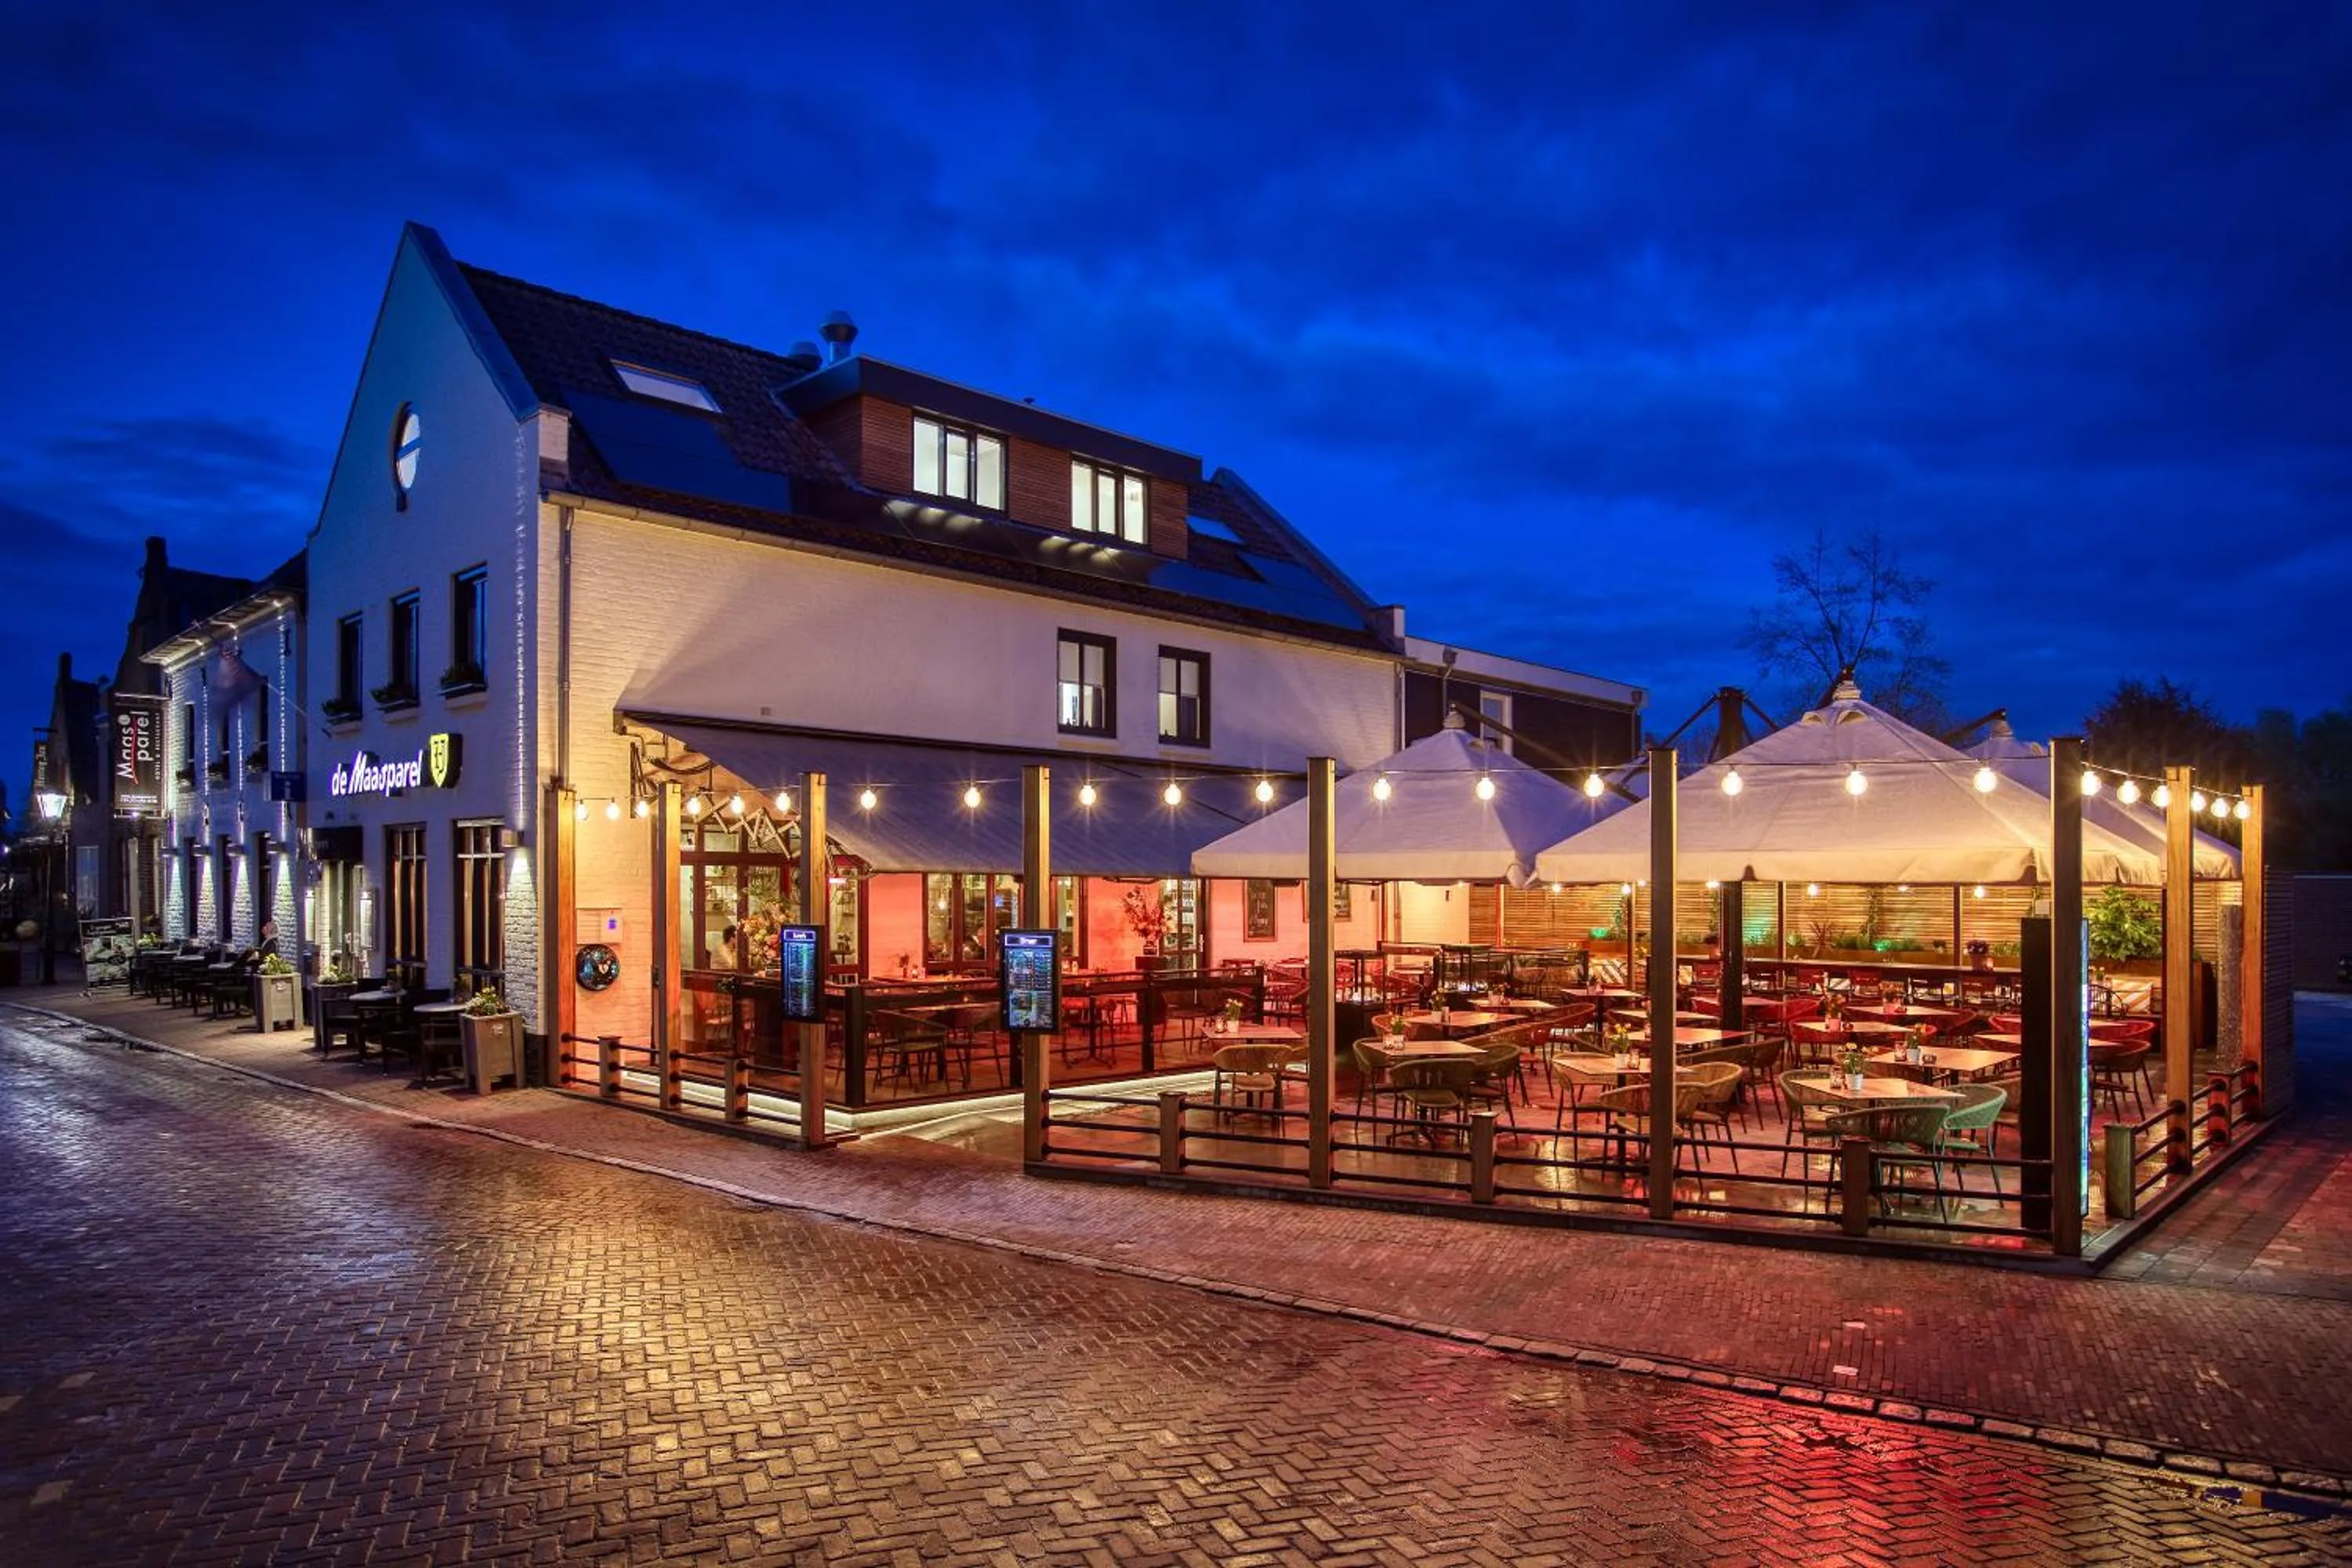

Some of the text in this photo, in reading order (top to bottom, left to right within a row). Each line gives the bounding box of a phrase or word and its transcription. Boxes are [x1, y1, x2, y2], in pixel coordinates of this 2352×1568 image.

[116, 727, 135, 779] Maas
[130, 711, 154, 761] parel
[332, 749, 423, 797] de Maasparel
